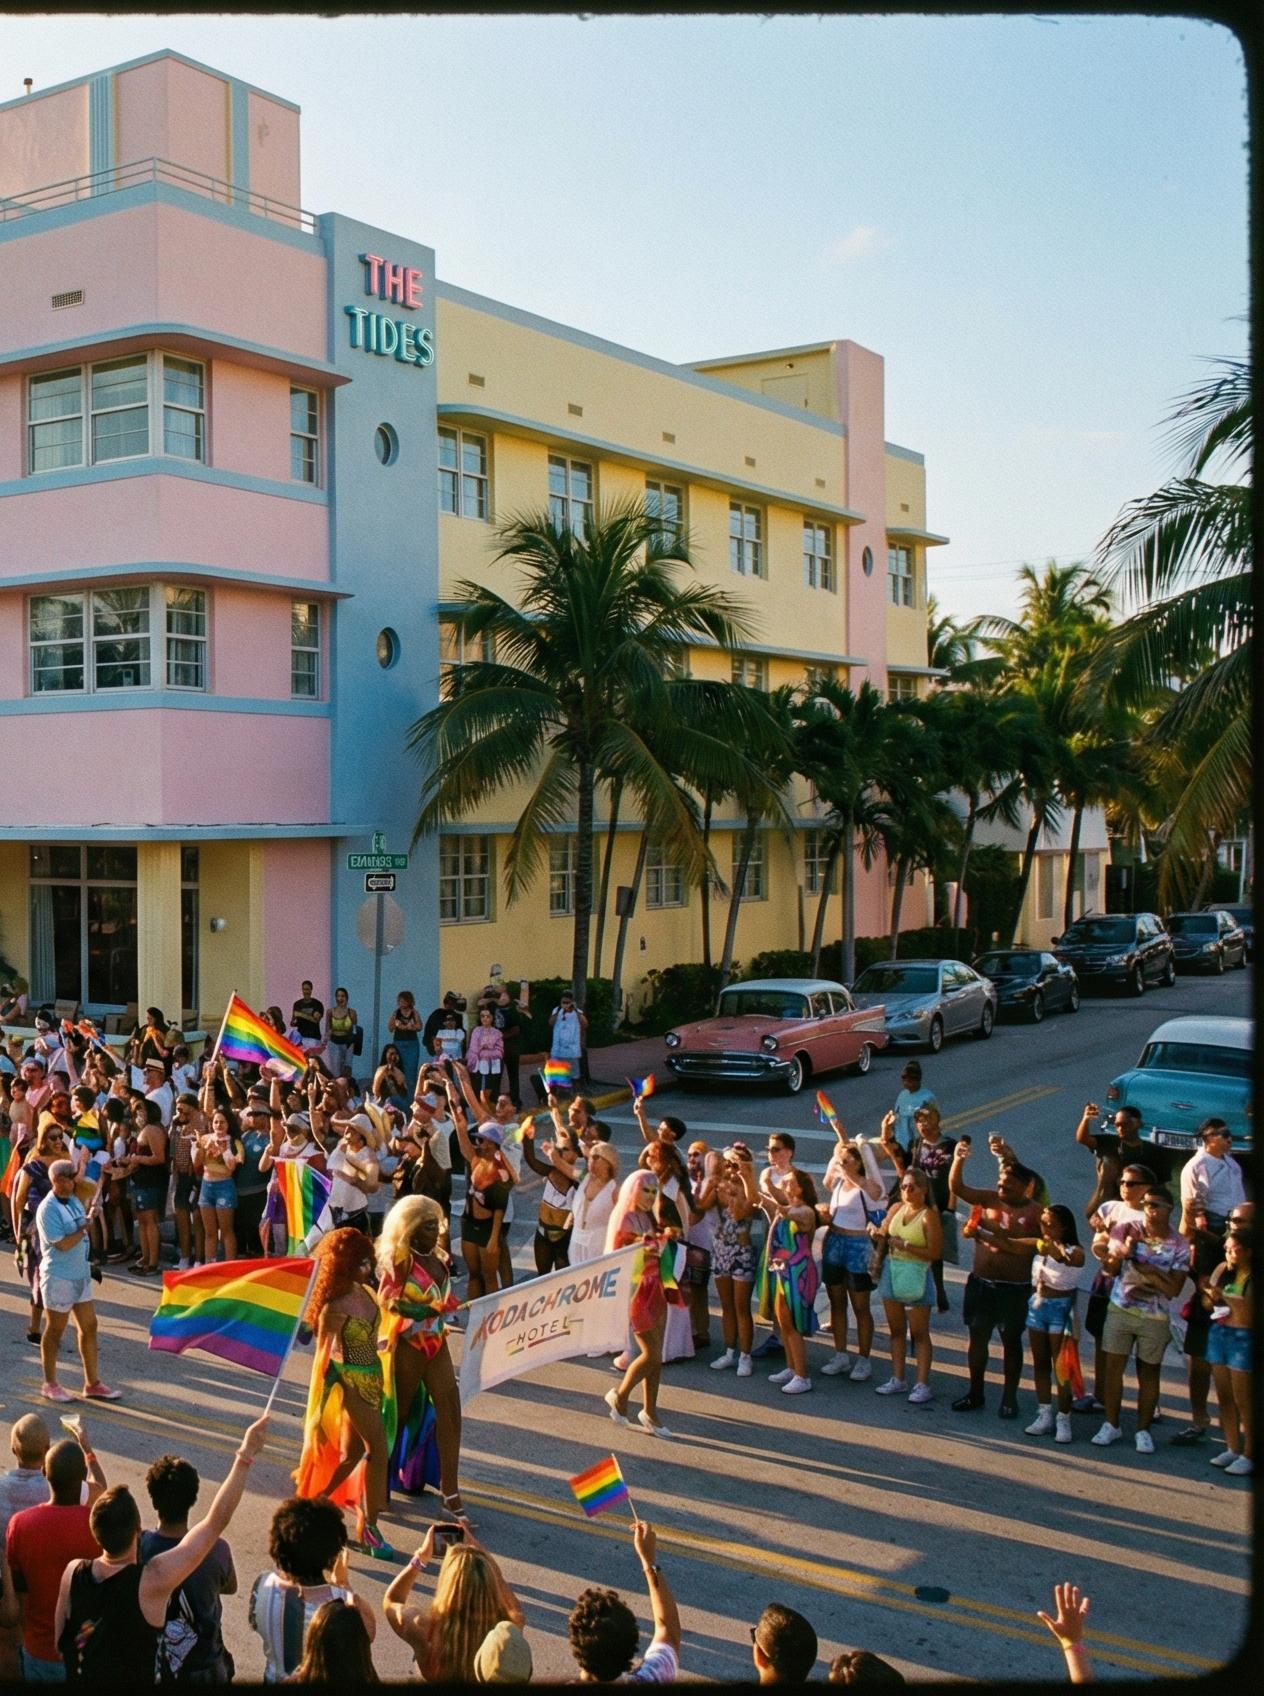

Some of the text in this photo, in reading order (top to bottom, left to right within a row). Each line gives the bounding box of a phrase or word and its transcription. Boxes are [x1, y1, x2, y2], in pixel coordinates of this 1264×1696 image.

[360, 252, 424, 310] THE
[347, 305, 434, 367] TIDES
[472, 1267, 621, 1350] KODACHROME
[516, 1316, 570, 1345] HOTEL
